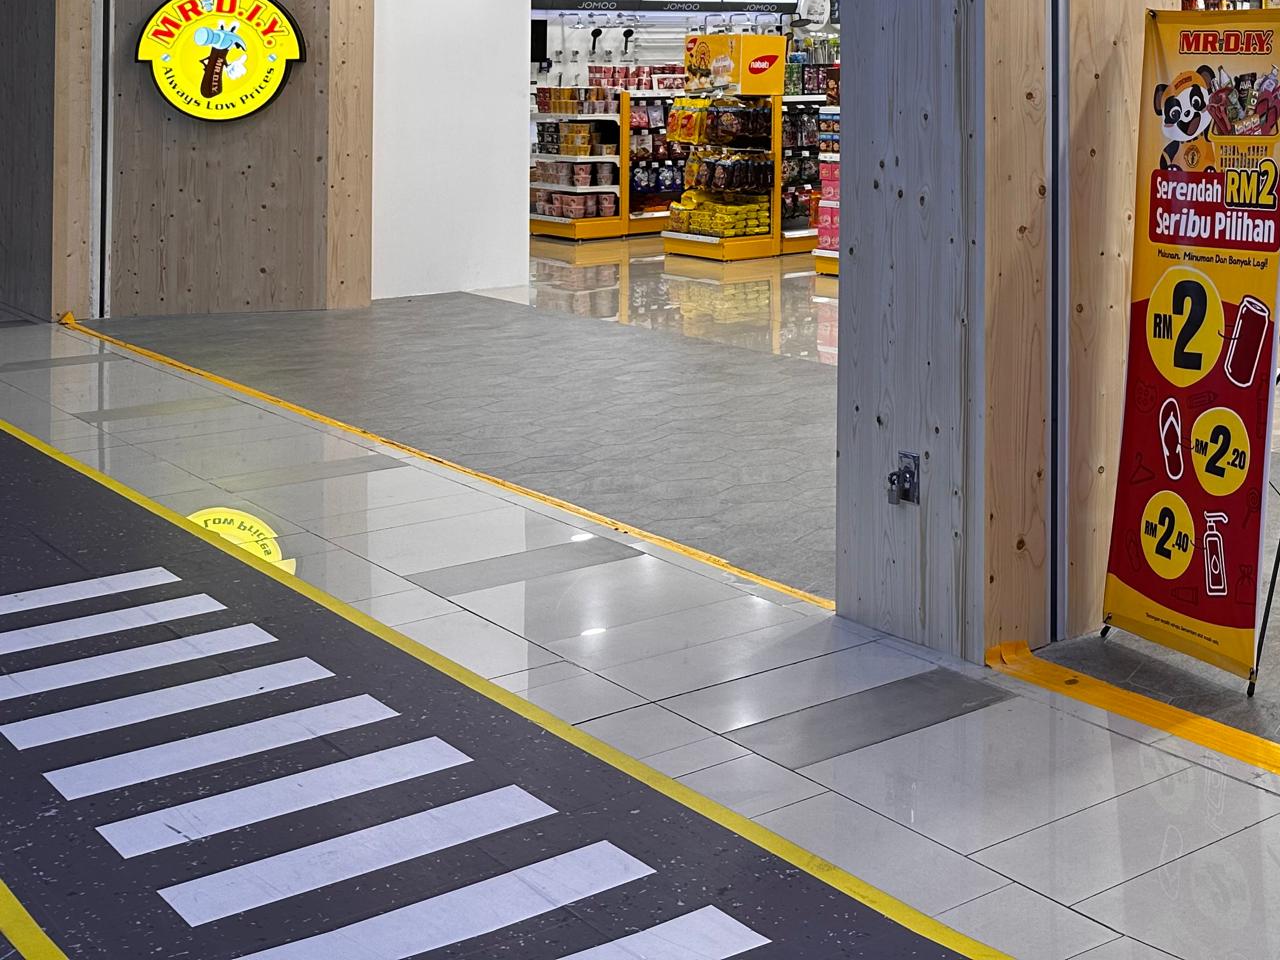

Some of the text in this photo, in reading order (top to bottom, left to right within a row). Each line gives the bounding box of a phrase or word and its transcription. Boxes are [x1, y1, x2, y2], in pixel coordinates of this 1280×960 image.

[577, 1, 617, 10] JOMOO
[663, 3, 700, 11] JOMOO
[743, 4, 777, 12] JOMOO
[162, 66, 275, 111] Always Low Prices
[1156, 176, 1221, 202] Serendah
[1156, 207, 1275, 243] Seribu Pilihan
[1183, 252, 1214, 263] Minuman
[1215, 254, 1228, 264] Dan
[1228, 255, 1252, 267] Banyak
